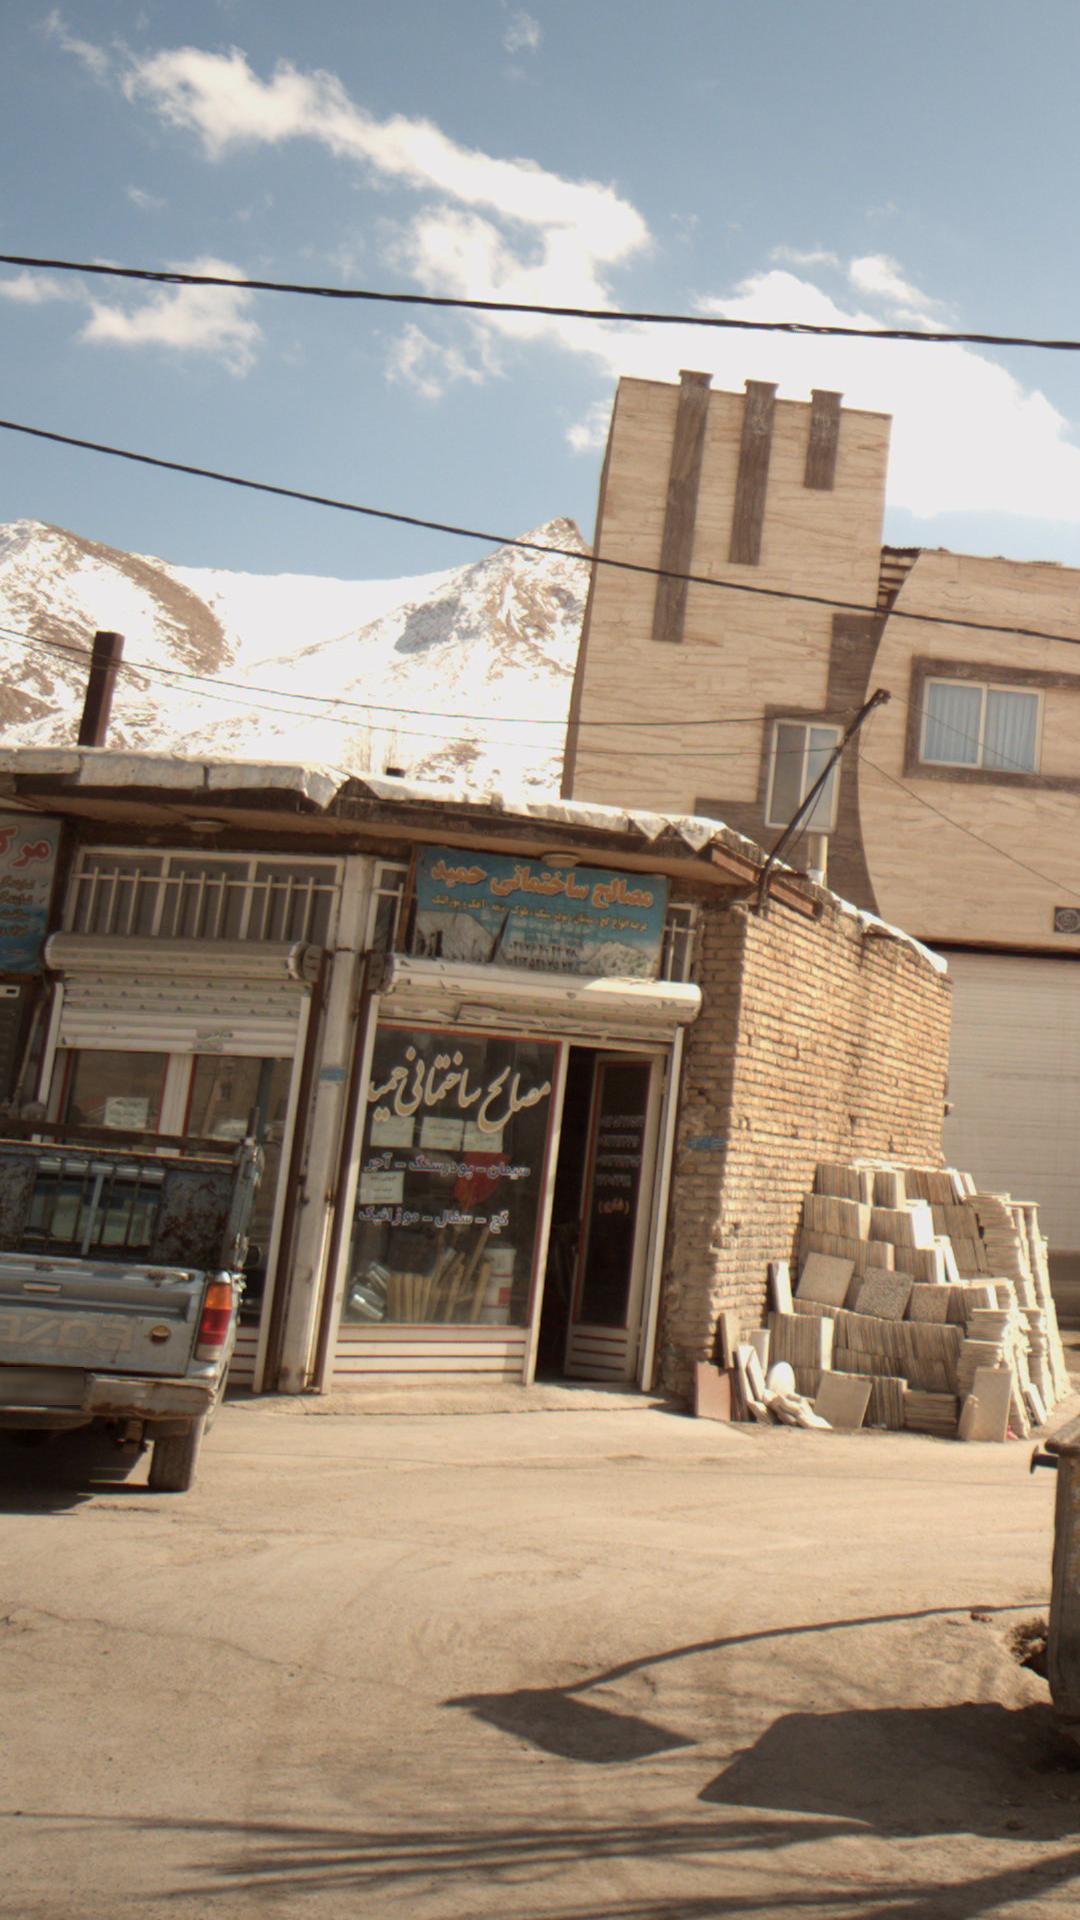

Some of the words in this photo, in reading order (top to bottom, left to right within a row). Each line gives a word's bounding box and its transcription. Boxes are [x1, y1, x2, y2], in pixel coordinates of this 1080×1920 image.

[431, 860, 487, 888] حمید
[490, 864, 589, 899] ساختمانی
[592, 877, 654, 909] مصالح
[394, 1046, 482, 1117] ساختمانی
[478, 1066, 551, 1133] مصالح
[363, 1152, 393, 1173] آجر
[487, 1162, 531, 1181] سیمان
[434, 1210, 473, 1228] سفال
[489, 1210, 509, 1234] گچ
